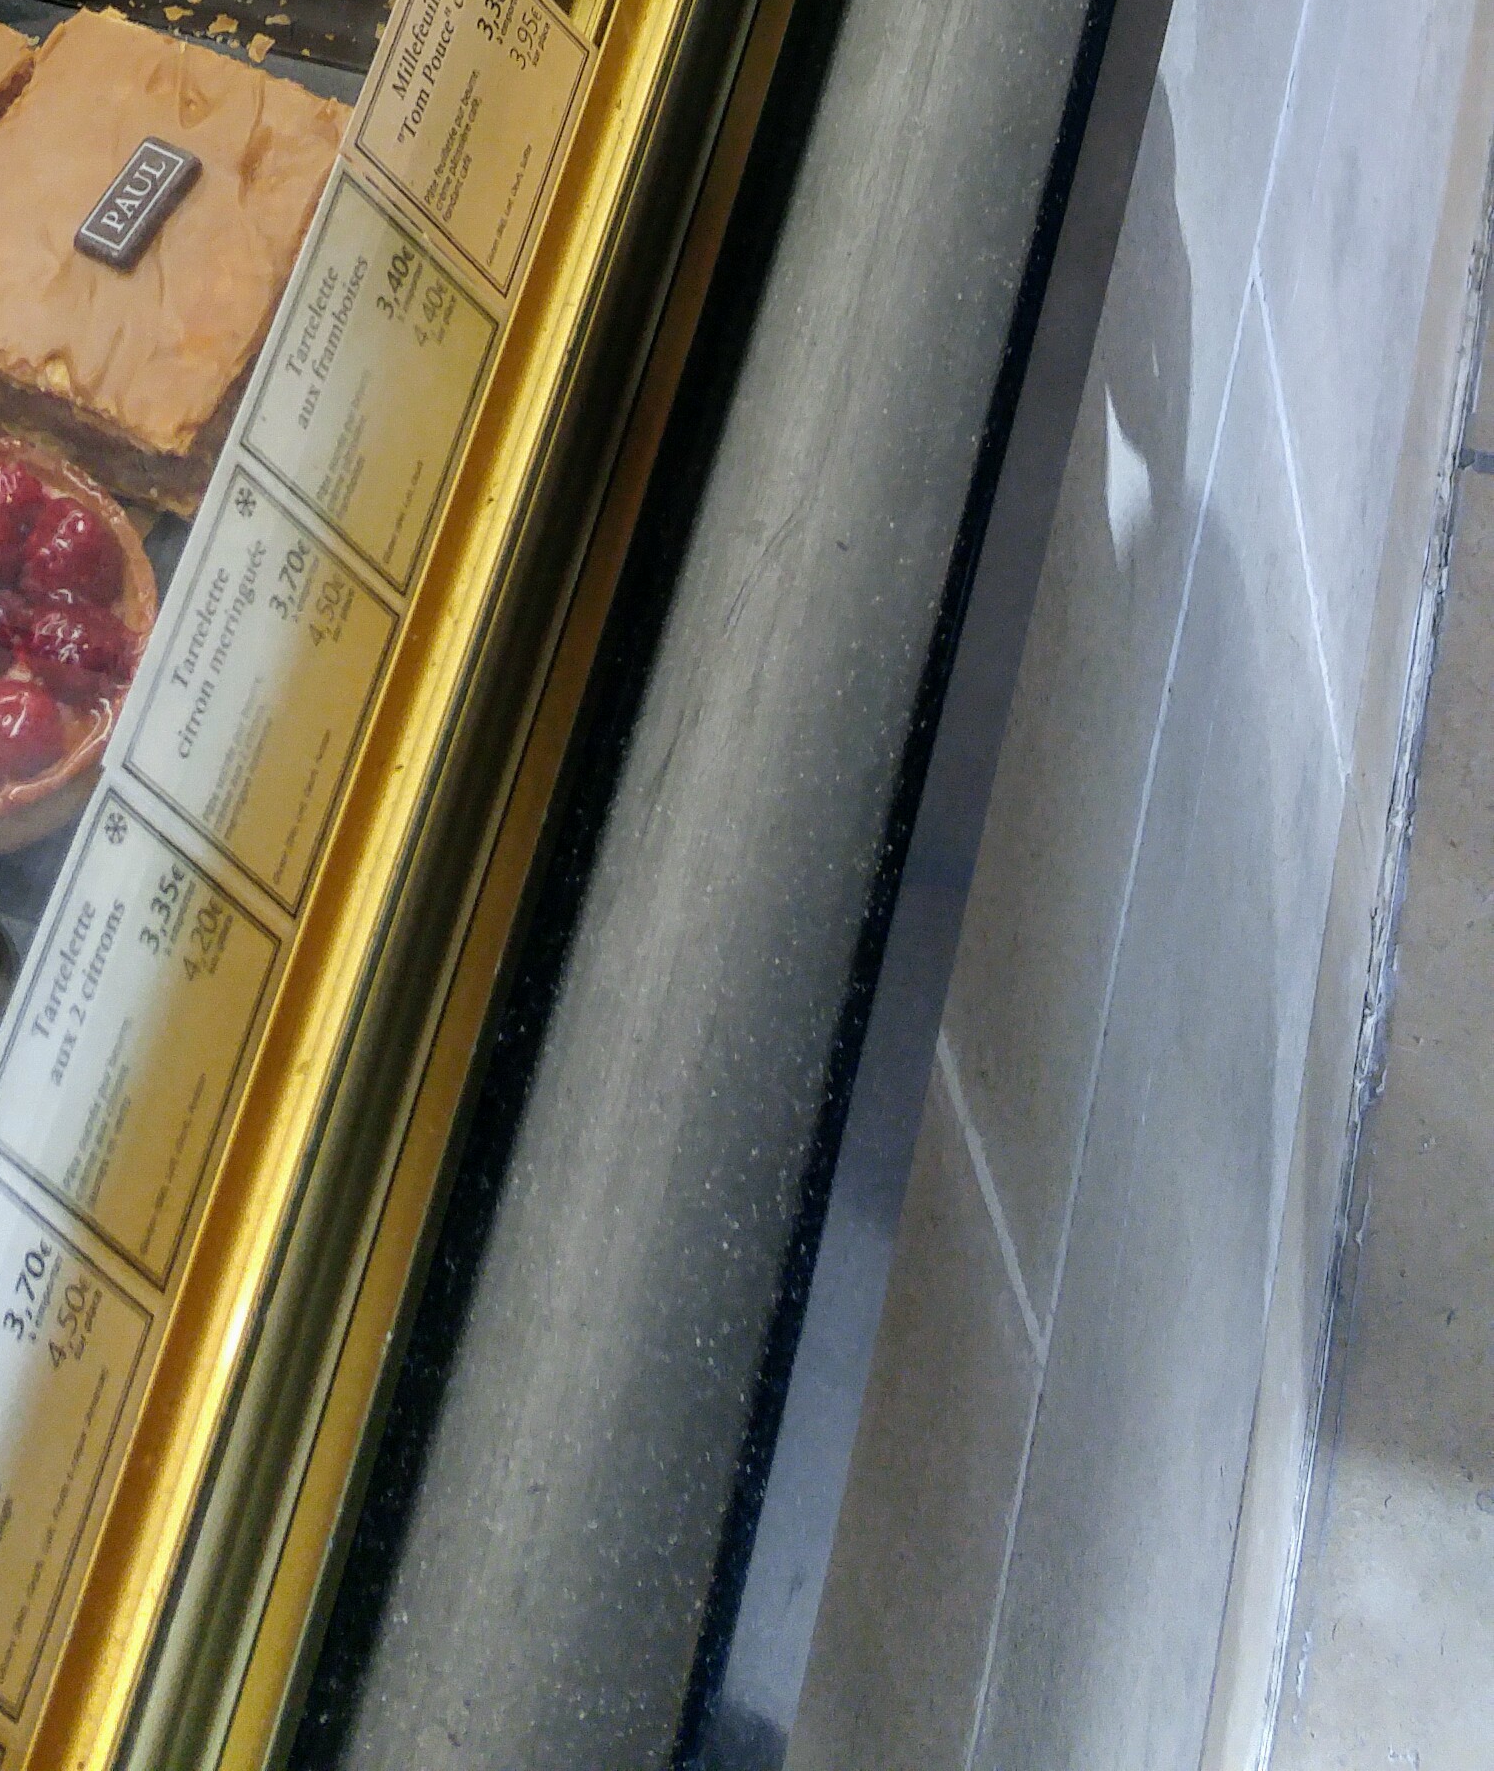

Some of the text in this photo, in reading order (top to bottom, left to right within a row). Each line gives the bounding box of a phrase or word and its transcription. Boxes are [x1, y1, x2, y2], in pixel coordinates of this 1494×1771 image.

[396, 88, 430, 143] "Tom
[421, 6, 454, 85] Pouce"
[508, 6, 541, 70] 3,95€
[531, 21, 550, 67] sur place
[100, 160, 166, 232] PAUL
[423, 178, 439, 205] Pâte
[453, 105, 464, 128] pur
[435, 175, 452, 211] crème
[441, 178, 463, 222] fondant
[285, 266, 338, 376] Tartelette
[375, 245, 414, 319] 3,40€
[412, 280, 447, 347] 4,40€
[297, 384, 320, 430] aux
[311, 255, 368, 381] framboises
[268, 539, 310, 620] 3,70€
[308, 573, 344, 646] 4,50€
[170, 567, 228, 687] Tartelette
[177, 679, 214, 759] citron
[209, 540, 266, 673] meringuée
[138, 864, 184, 954] 3,35€
[182, 898, 223, 981] 4,20€
[30, 901, 95, 1037] Tartelette
[50, 898, 125, 1085] aux 2 citrons
[2, 1241, 51, 1340] 3,70€
[48, 1278, 89, 1369] 4,50€
